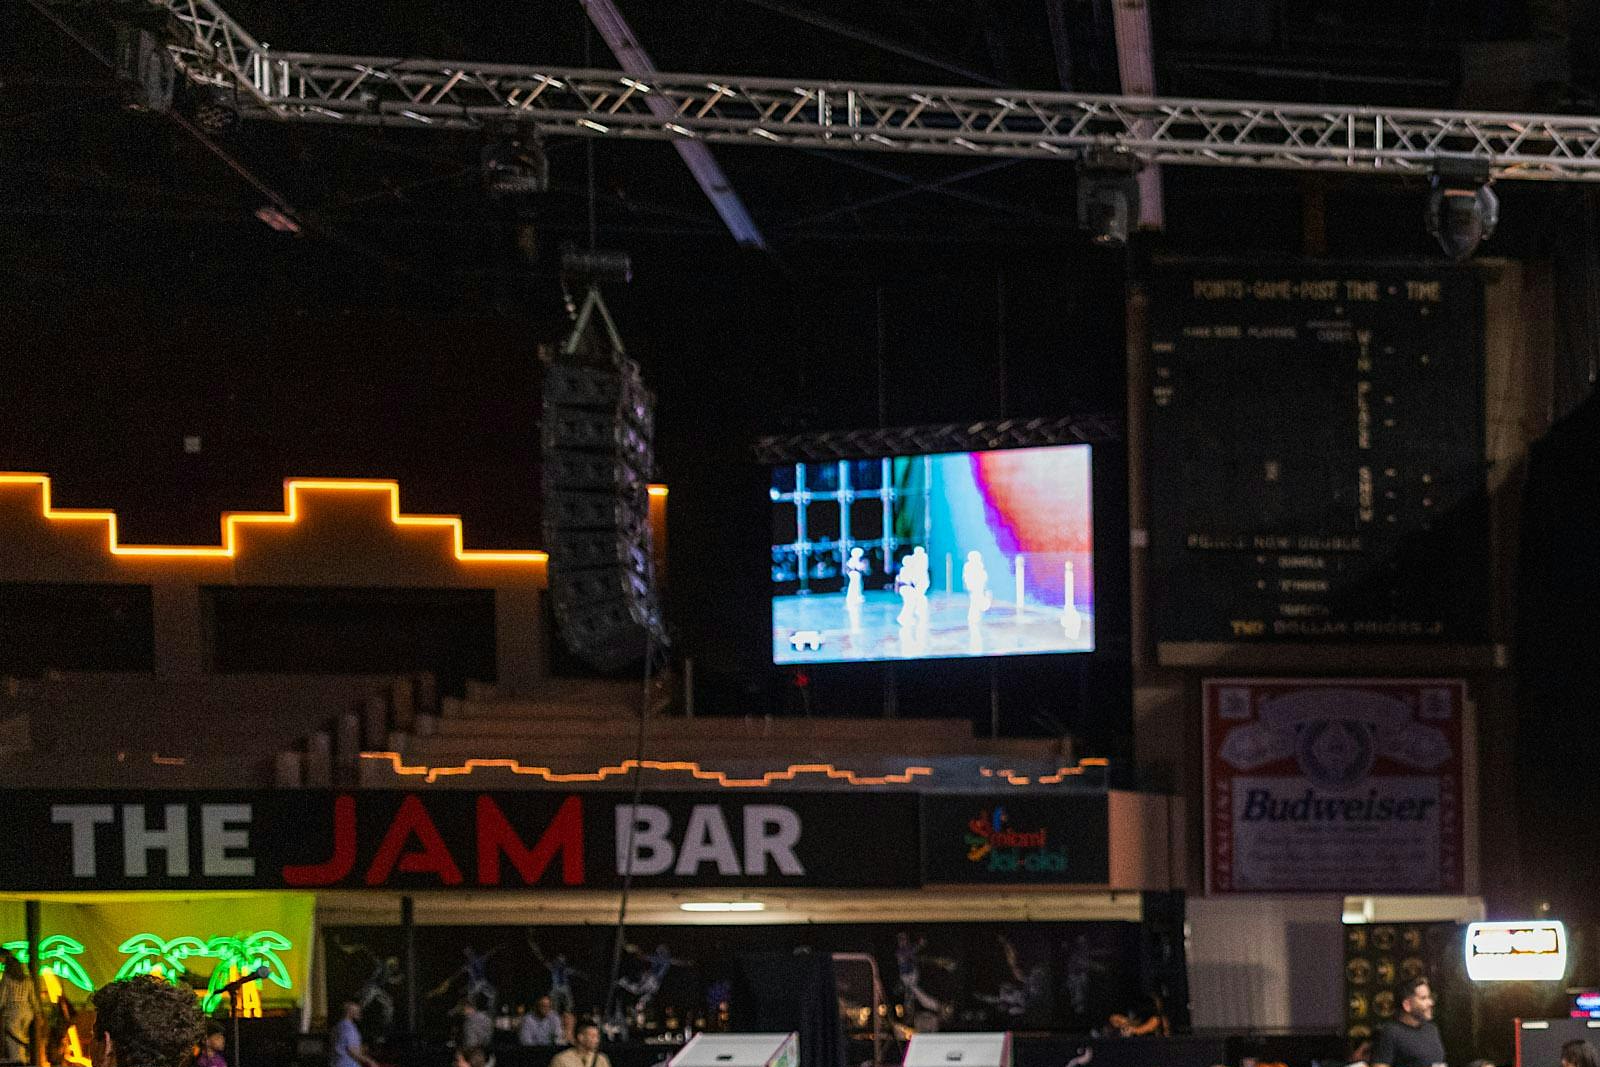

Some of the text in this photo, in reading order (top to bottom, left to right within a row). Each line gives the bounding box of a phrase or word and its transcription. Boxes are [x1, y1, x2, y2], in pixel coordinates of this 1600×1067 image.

[1241, 788, 1436, 822] Budweiser
[51, 795, 805, 885] THE JAM BAR
